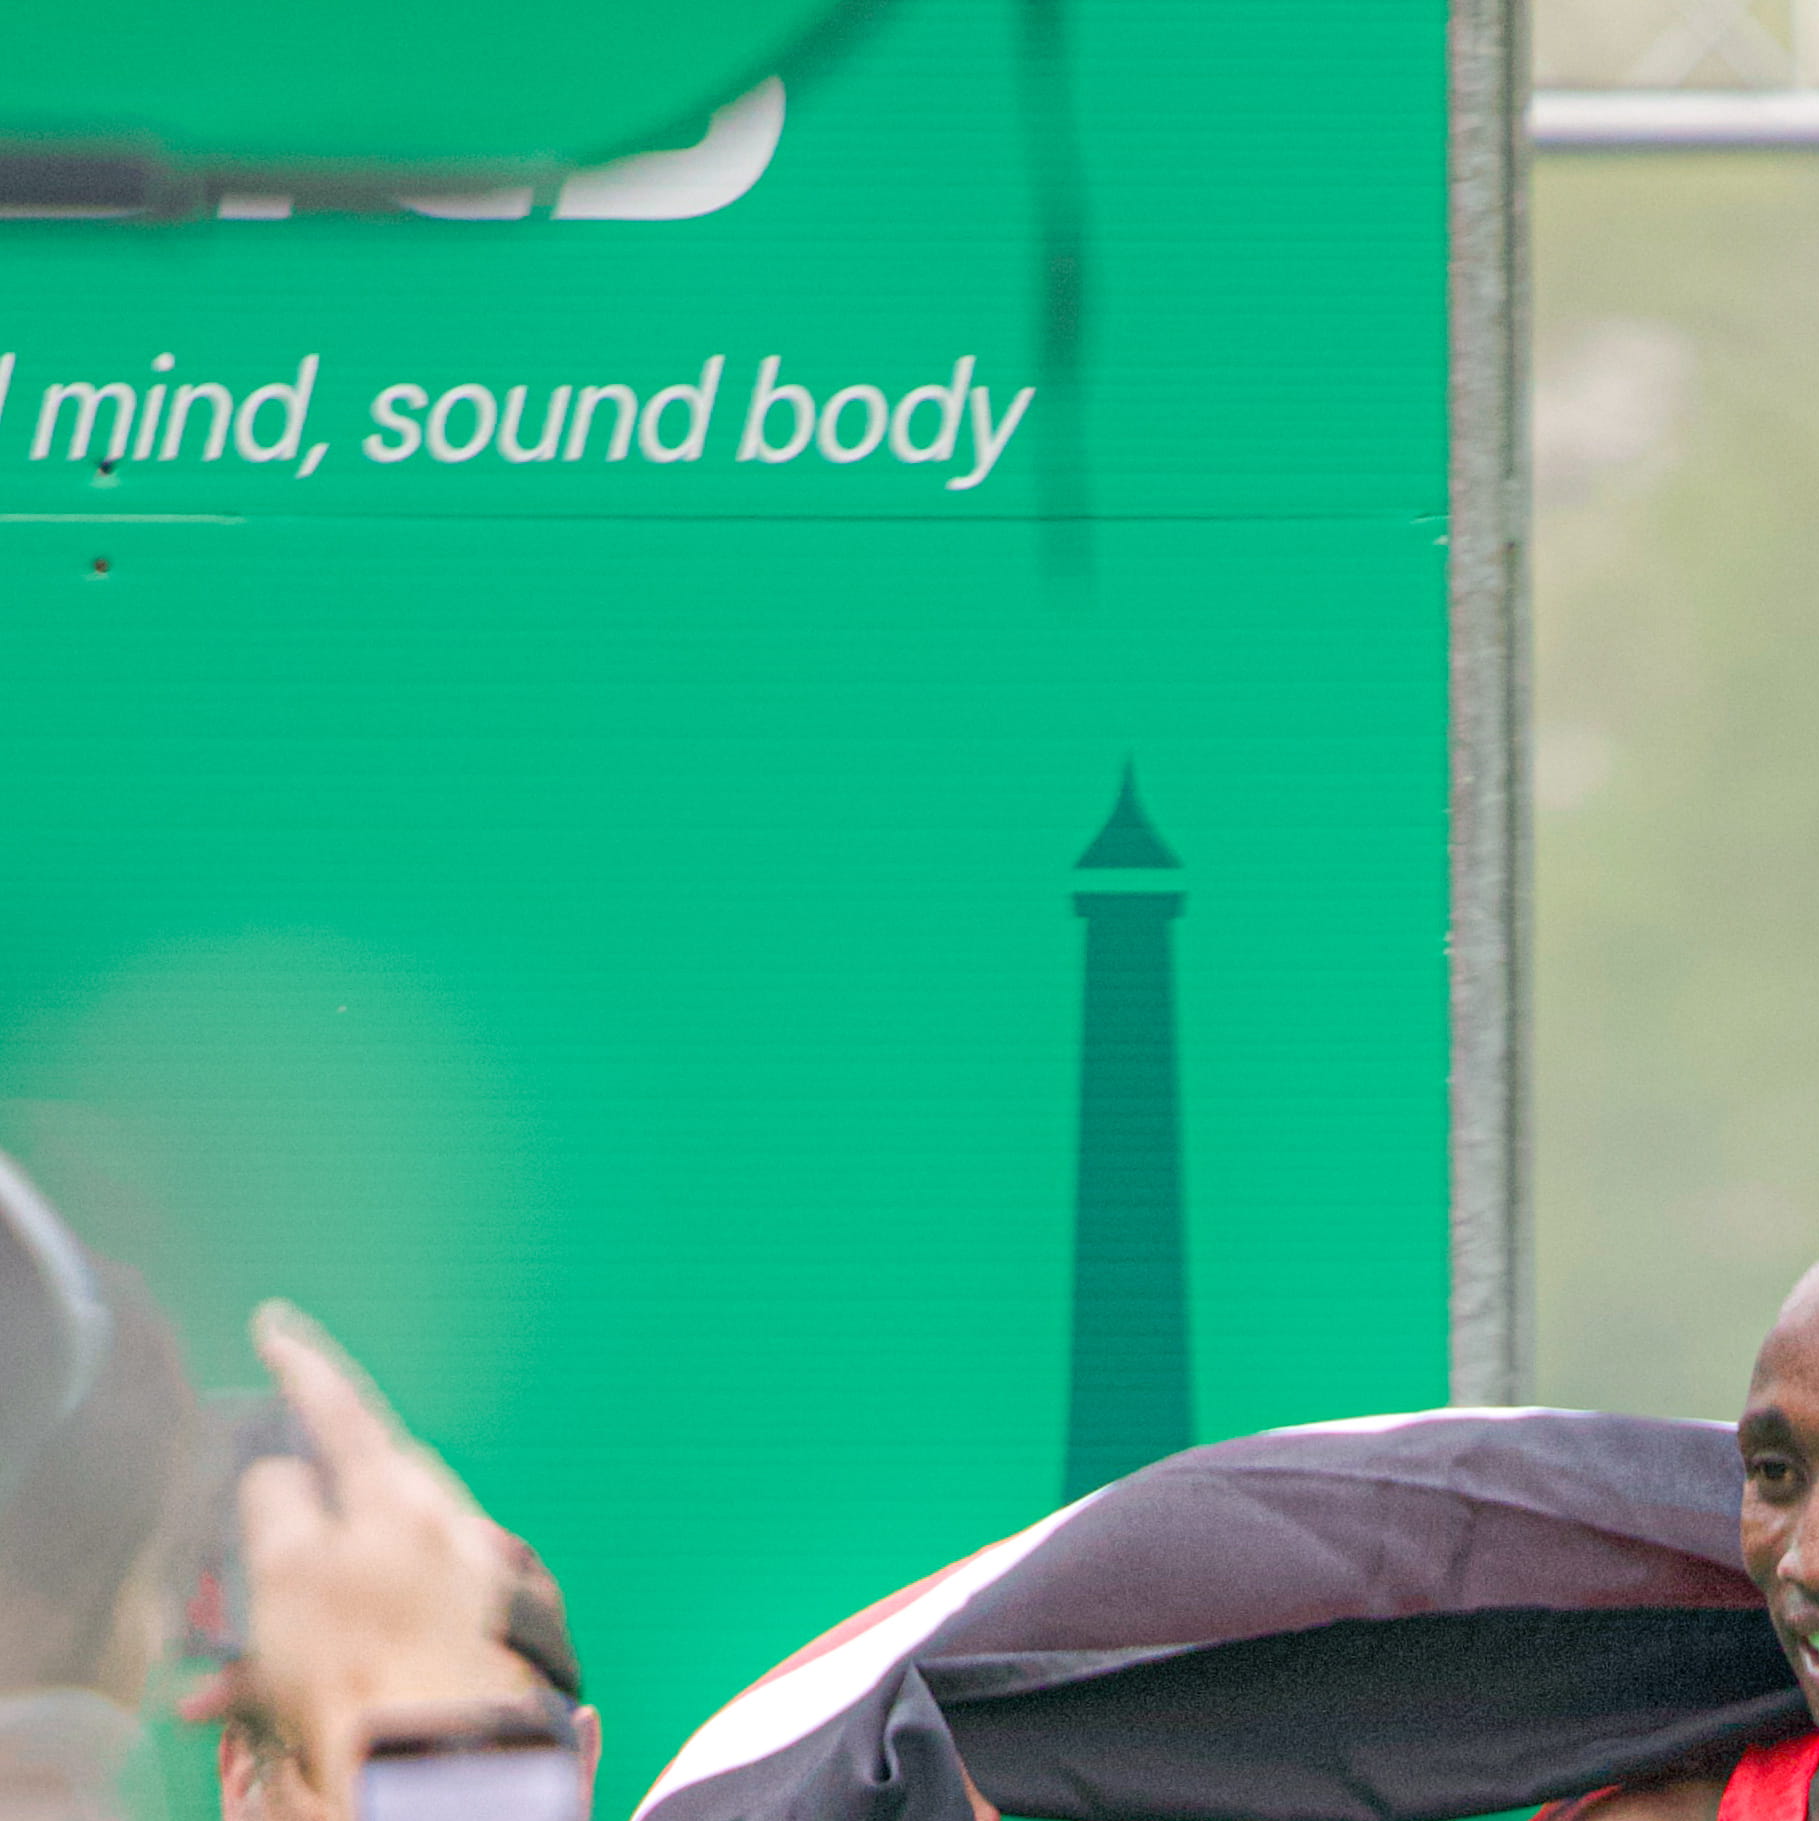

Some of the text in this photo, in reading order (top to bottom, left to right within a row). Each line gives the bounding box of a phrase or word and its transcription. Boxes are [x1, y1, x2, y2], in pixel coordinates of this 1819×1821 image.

[30, 353, 329, 480] mind,
[364, 354, 726, 465] sound
[737, 354, 1037, 491] body
